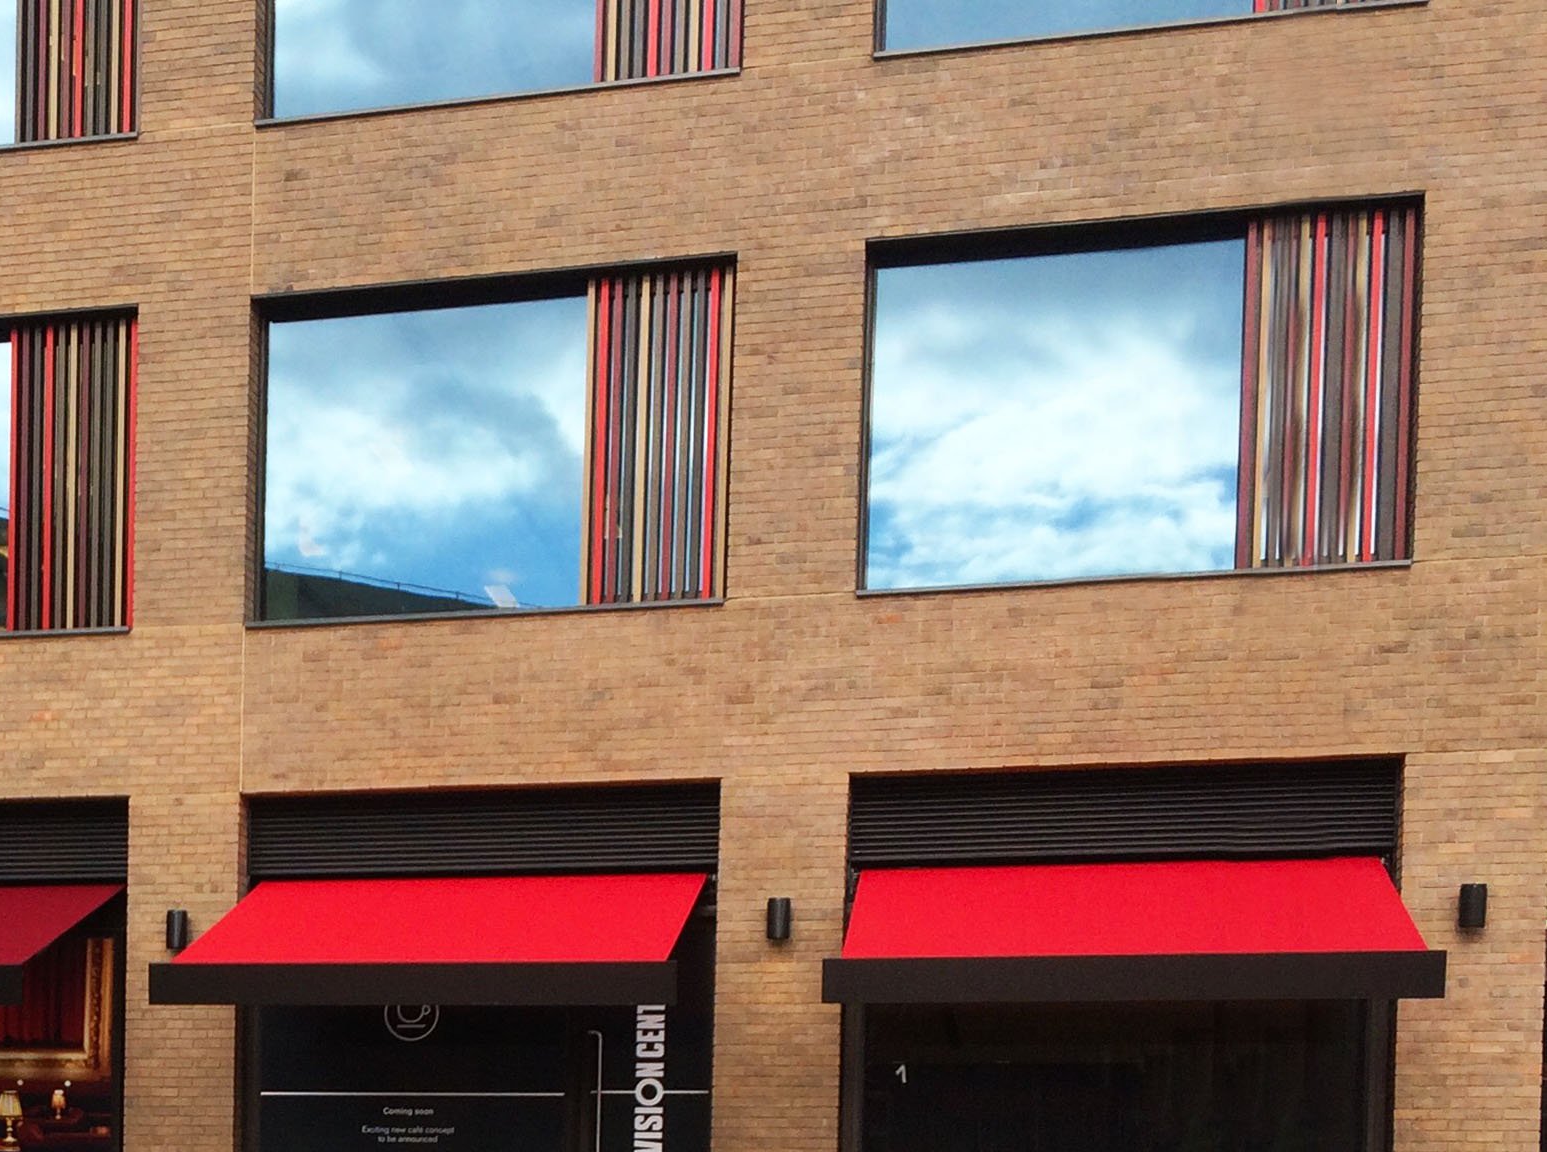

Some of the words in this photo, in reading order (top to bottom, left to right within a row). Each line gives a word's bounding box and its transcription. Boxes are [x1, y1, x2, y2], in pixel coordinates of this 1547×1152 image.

[382, 1107, 413, 1116] Coming
[361, 1125, 390, 1135] Exciting
[425, 1127, 455, 1136] concept
[386, 1135, 396, 1143] be
[397, 1135, 438, 1143] announced
